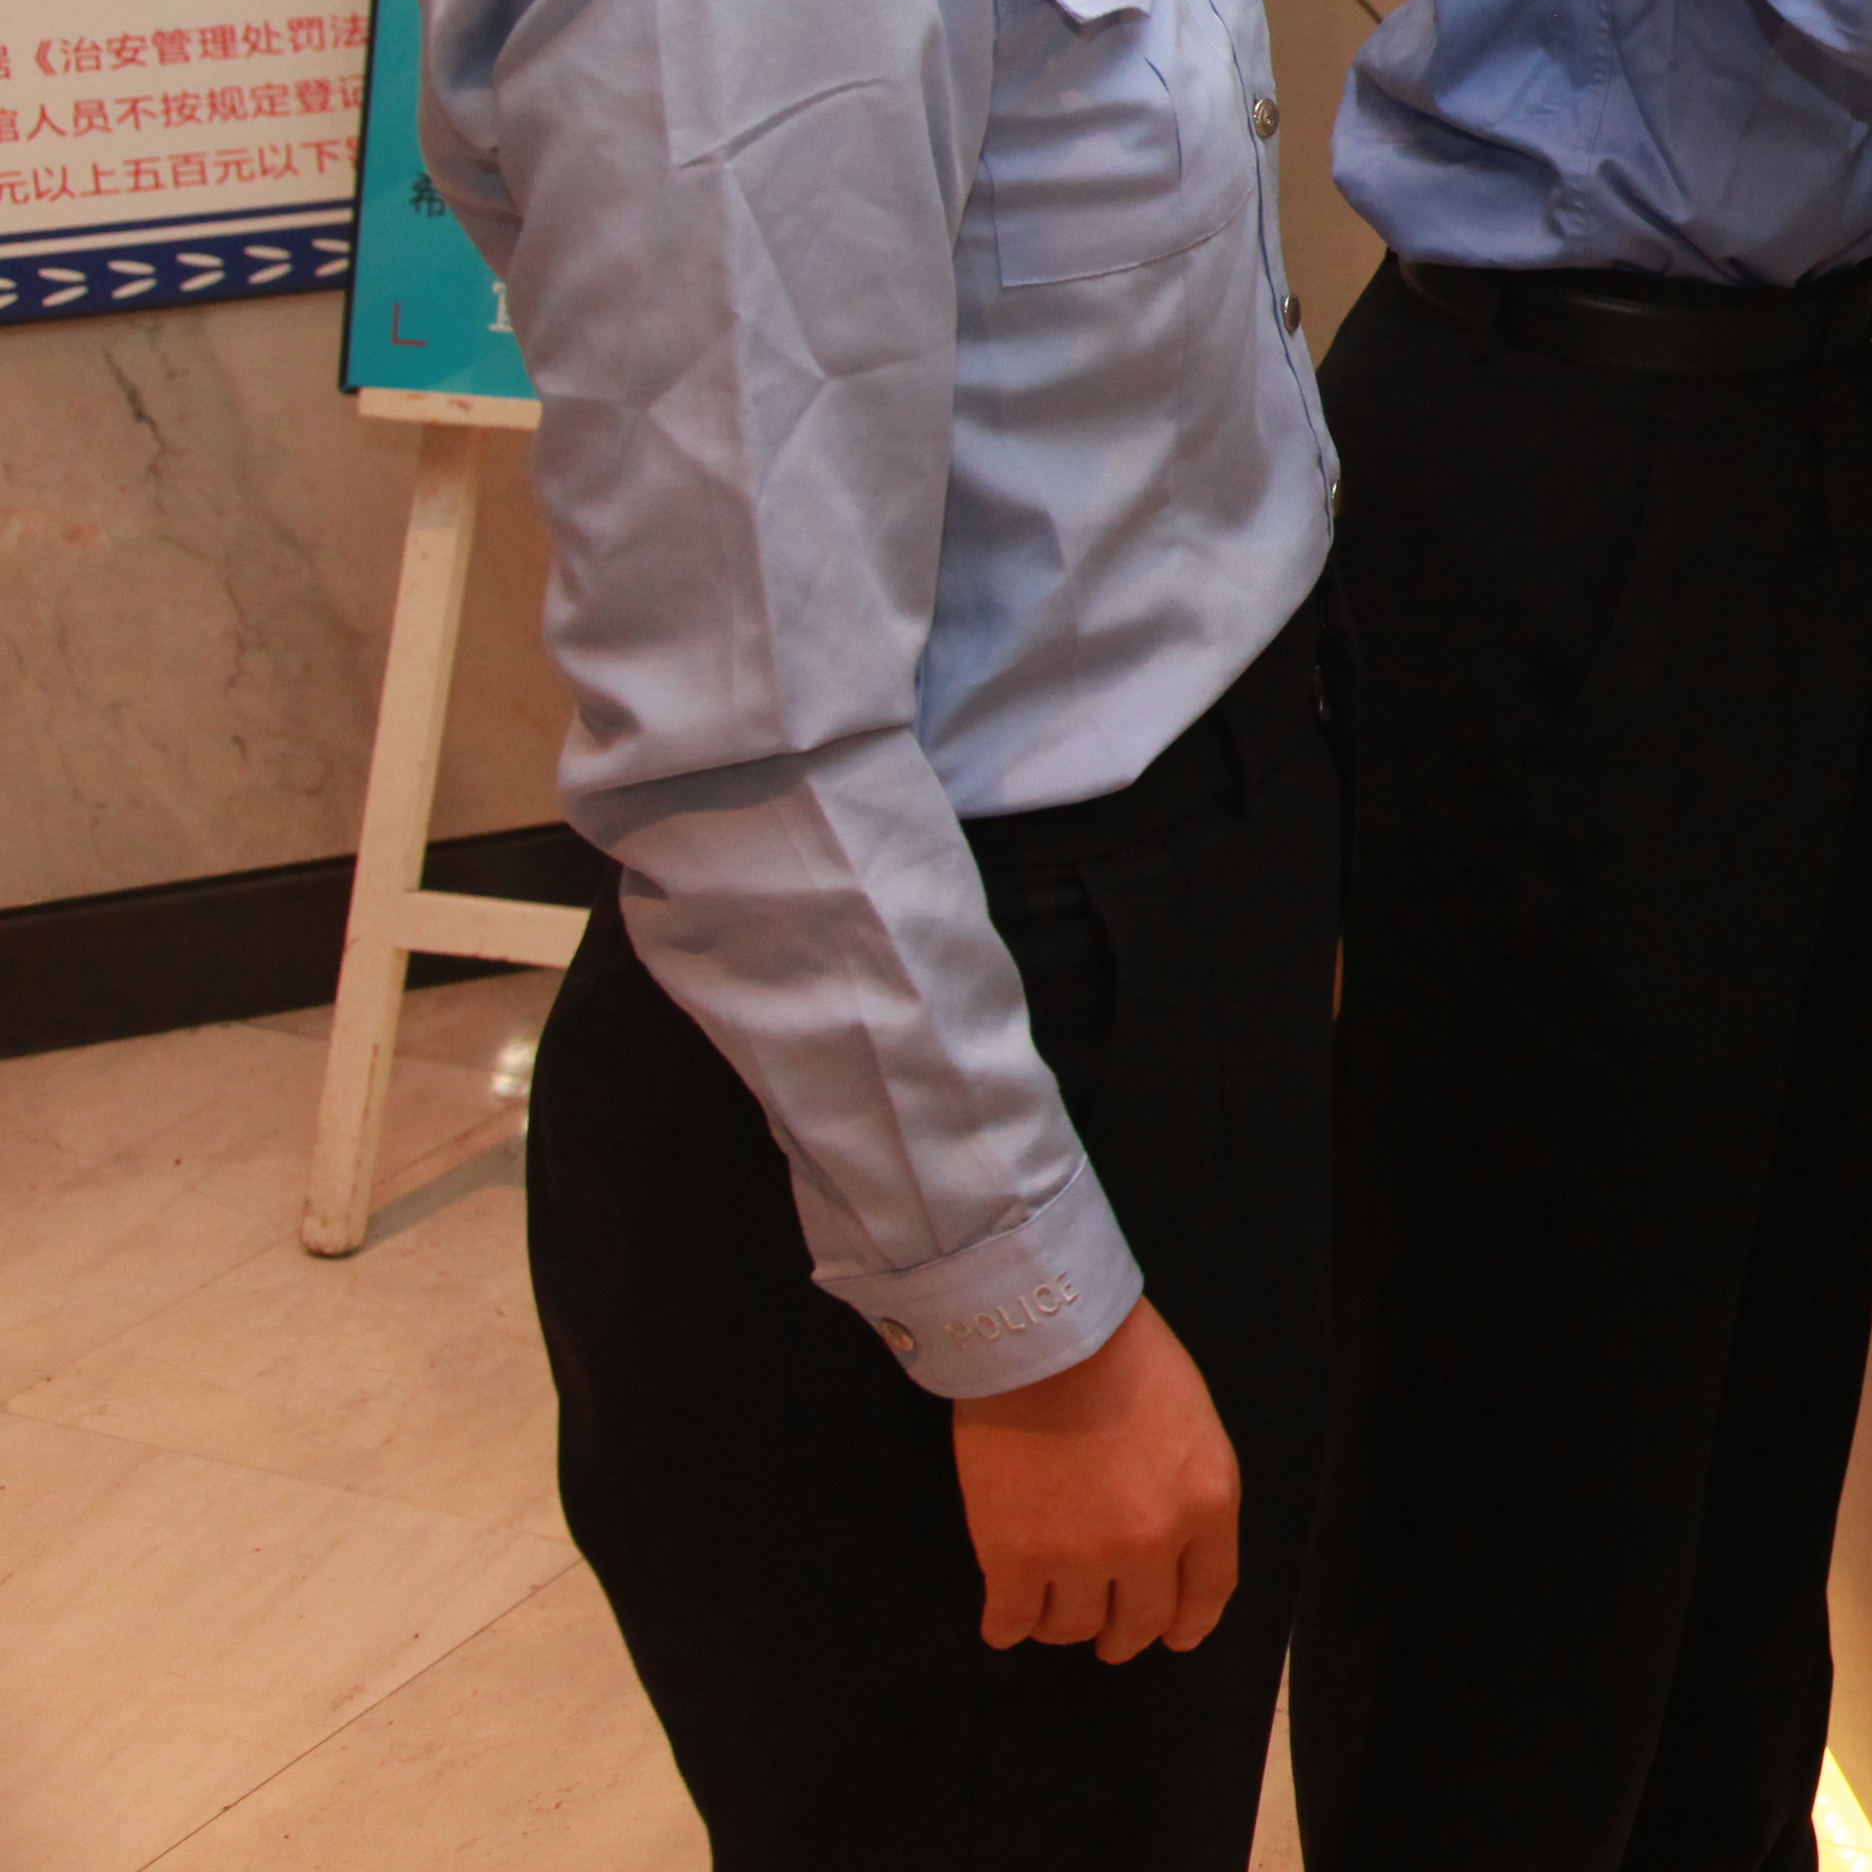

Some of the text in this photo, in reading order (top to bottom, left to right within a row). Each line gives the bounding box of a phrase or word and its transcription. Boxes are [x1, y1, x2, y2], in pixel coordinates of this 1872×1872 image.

[0, 13, 369, 80] 《治安管理处罚法
[0, 135, 360, 205] 元以上五百元以下
[944, 1270, 1080, 1349] POLICE
